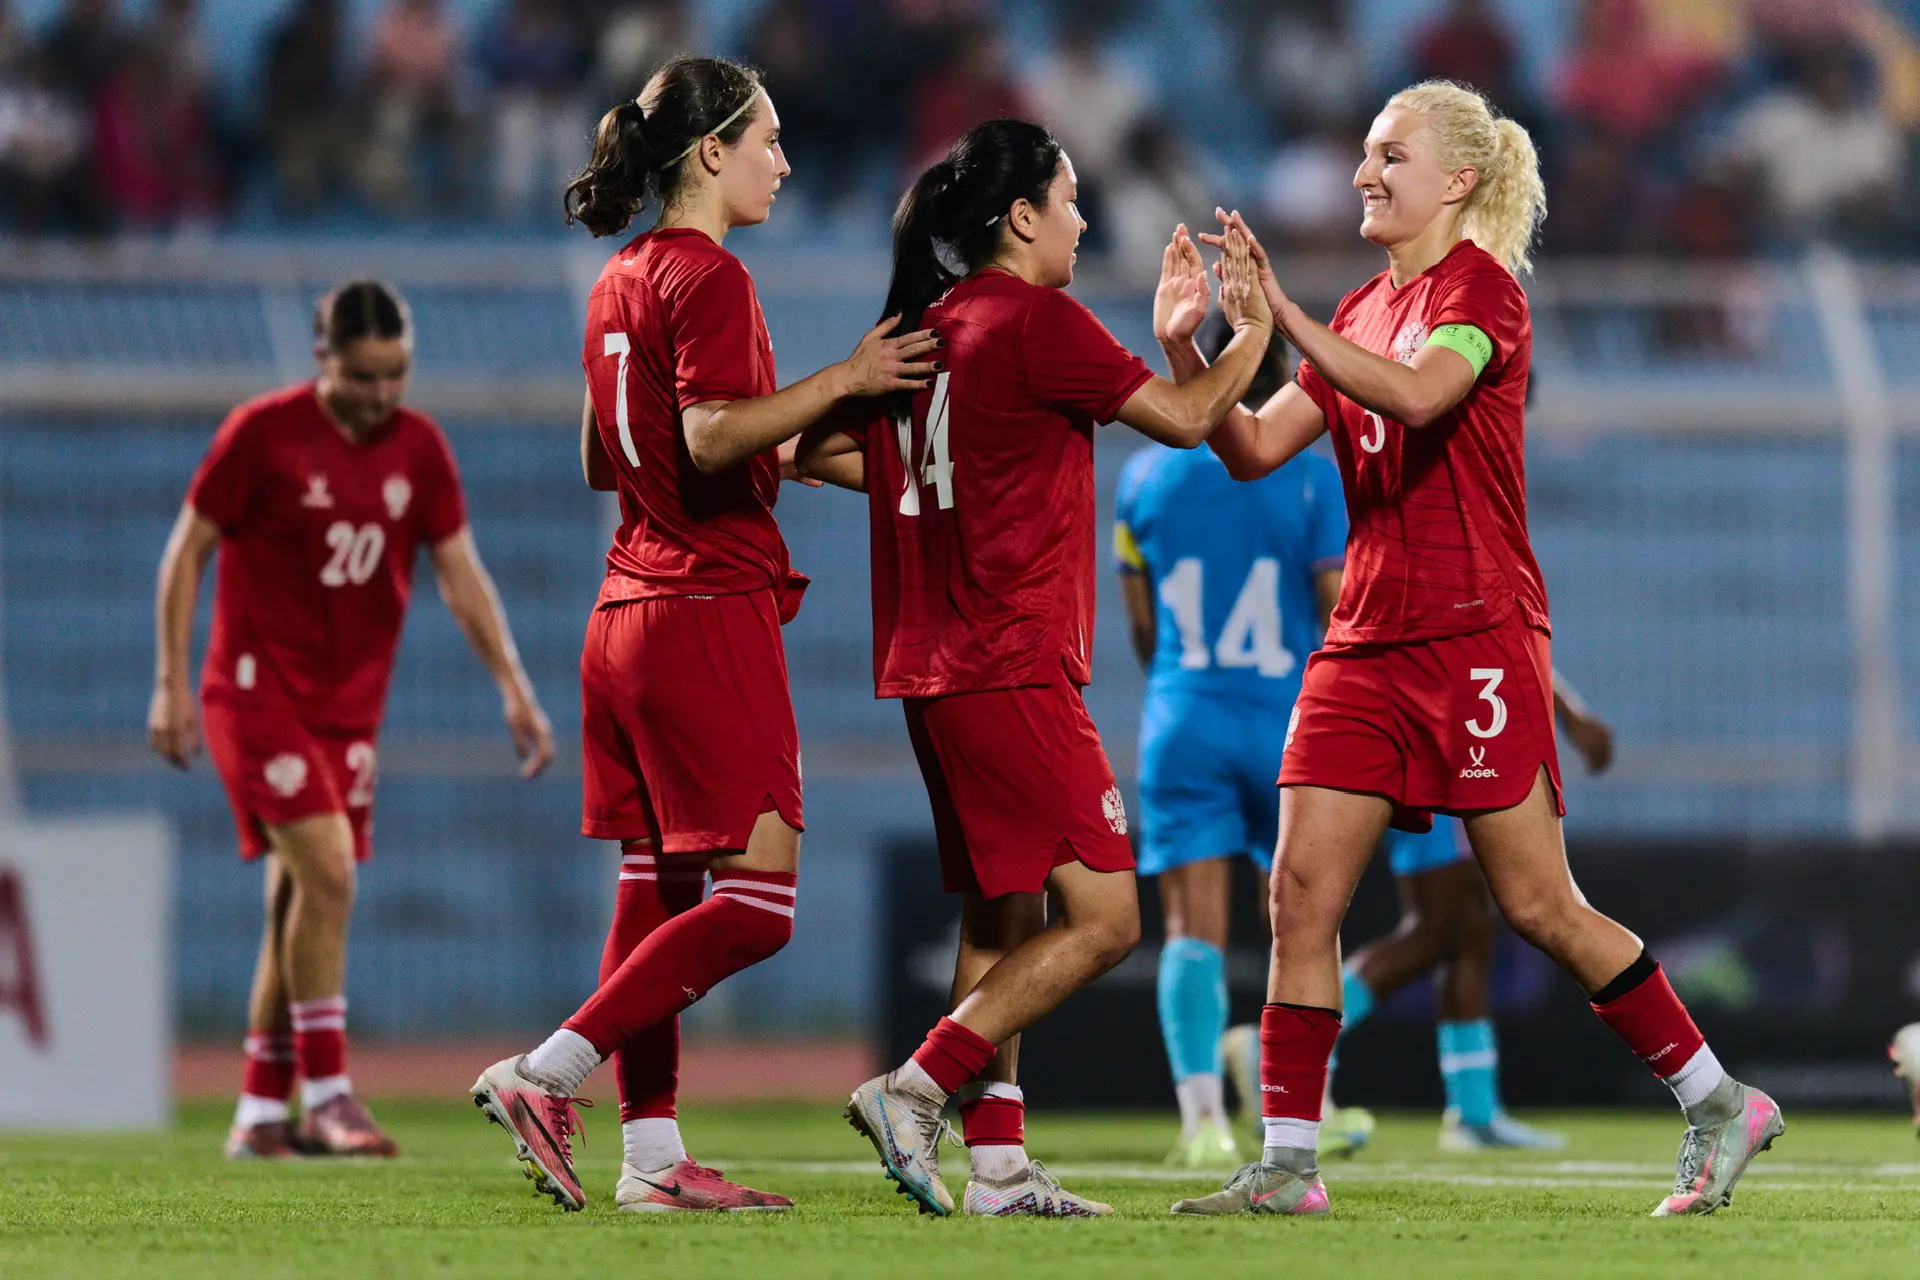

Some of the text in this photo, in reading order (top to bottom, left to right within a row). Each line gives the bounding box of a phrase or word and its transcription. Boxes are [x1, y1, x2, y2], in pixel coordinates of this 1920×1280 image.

[604, 332, 641, 468] 7
[897, 371, 955, 516] 14
[320, 520, 385, 587] 20
[1159, 558, 1295, 679] 14
[1465, 668, 1508, 738] 3
[346, 741, 377, 808] 2
